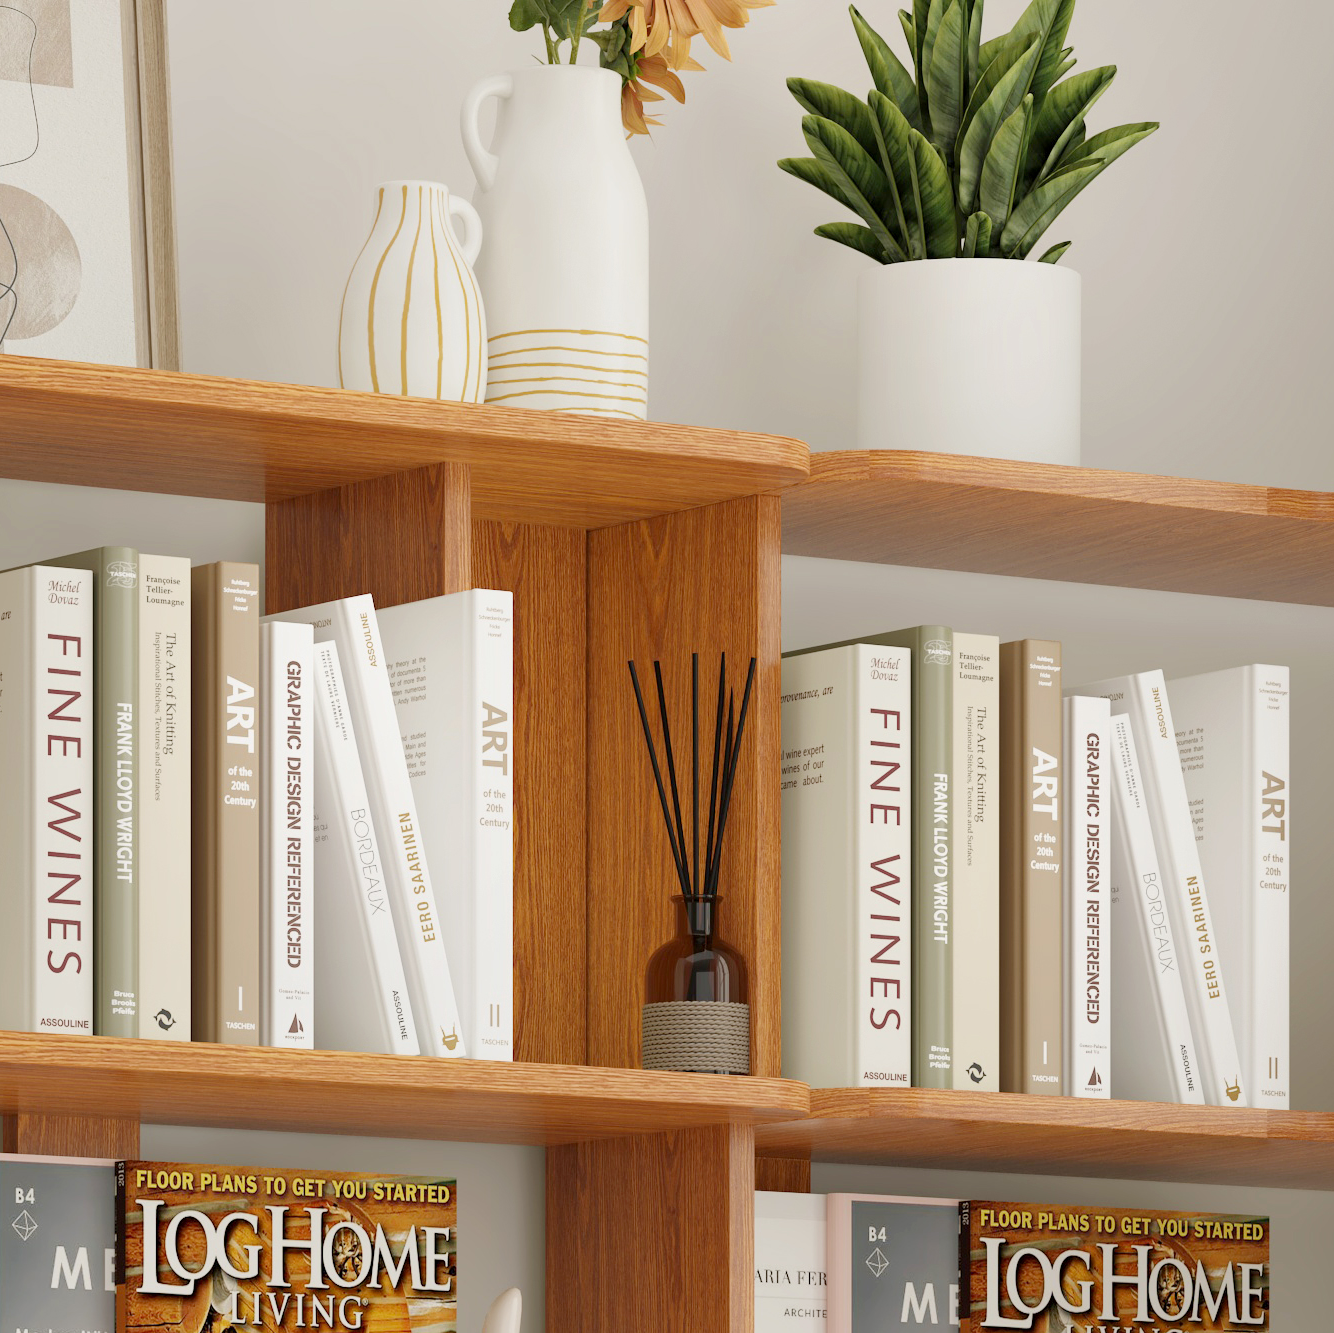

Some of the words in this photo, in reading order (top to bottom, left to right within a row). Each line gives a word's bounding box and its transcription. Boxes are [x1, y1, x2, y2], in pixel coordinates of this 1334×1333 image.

[48, 580, 82, 594] Michel
[48, 592, 79, 606] Dovaz
[145, 585, 171, 595] Tellier-
[146, 574, 181, 586] Françoise
[146, 595, 185, 608] Loumagne
[165, 632, 177, 657] The
[359, 612, 378, 667] ASSOULINE
[47, 633, 82, 759] FINE
[166, 661, 177, 676] Art
[166, 677, 175, 689] of
[115, 700, 135, 759] FRANK
[162, 689, 177, 755] Knitting
[226, 675, 255, 754] ART
[286, 660, 302, 750] GRAPHIC
[481, 701, 508, 776] ART
[114, 760, 135, 816] LLOYD
[227, 765, 238, 776] of
[238, 764, 255, 779] the
[230, 780, 250, 792] 20th
[286, 756, 302, 830] DESIGN
[869, 707, 901, 826] FINE
[1032, 747, 1058, 821] ART
[1086, 732, 1100, 818] GRAPHIC
[224, 794, 257, 809] Century
[933, 773, 948, 824] FRANK
[114, 816, 135, 885] WRIGHT
[350, 808, 386, 916] BORDEAUX
[398, 812, 426, 895] SAARINEN
[932, 827, 950, 878] LLOYD
[1086, 823, 1100, 893] DESIGN
[46, 788, 82, 975] WINES
[287, 837, 302, 969] REFERENCED
[416, 901, 436, 943] EERO
[933, 881, 949, 945] WRIGHT
[1142, 872, 1173, 974] BORDEAUX
[869, 854, 901, 1030] WINES
[1086, 899, 1100, 1024] REFERENCED
[40, 1017, 89, 1029] ASSOULINE
[225, 1020, 256, 1030] TASCHEN
[392, 990, 408, 1041] ASSOULINE
[15, 1187, 36, 1205] B4
[979, 1208, 1036, 1234] FLOOR
[1038, 1210, 1092, 1235] PLANS
[1094, 1215, 1119, 1237] TO
[1120, 1216, 1153, 1241] GET
[1157, 1218, 1191, 1239] YOU
[1192, 1217, 1266, 1243] STARTED
[230, 1289, 365, 1331] LIVING
